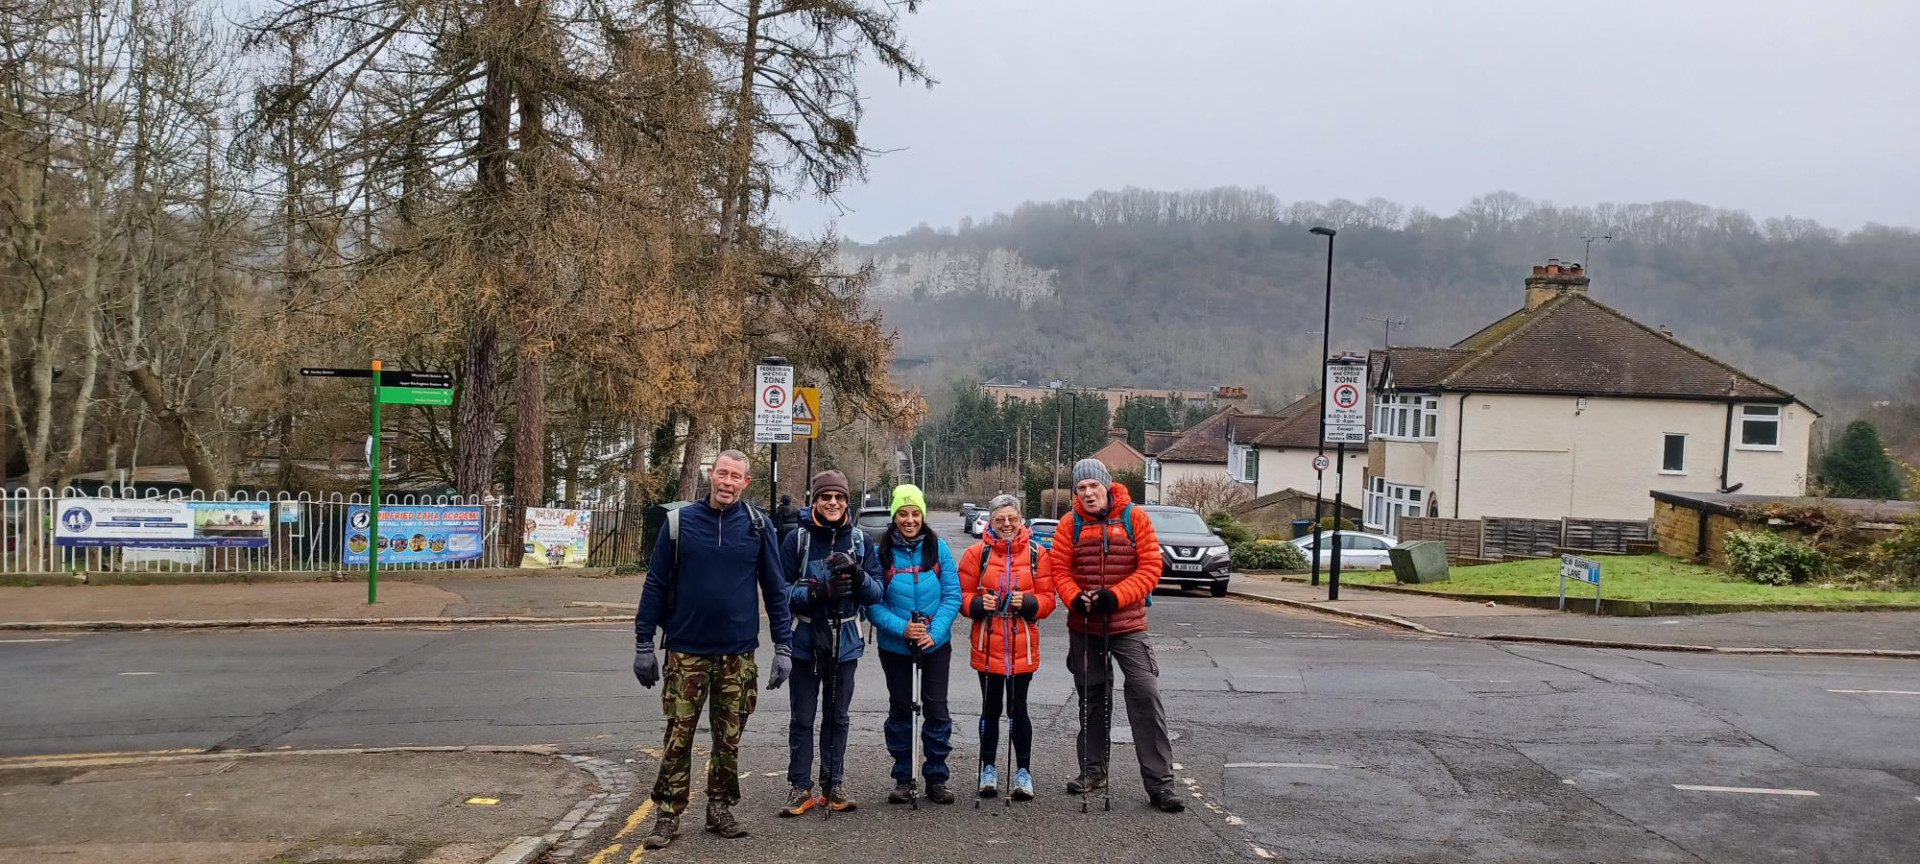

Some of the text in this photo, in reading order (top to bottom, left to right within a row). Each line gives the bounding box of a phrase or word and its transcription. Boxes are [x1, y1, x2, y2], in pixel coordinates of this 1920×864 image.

[416, 511, 440, 520] ZAHA
[1561, 556, 1589, 570] NEW BARN
[1567, 568, 1581, 579] LANE
